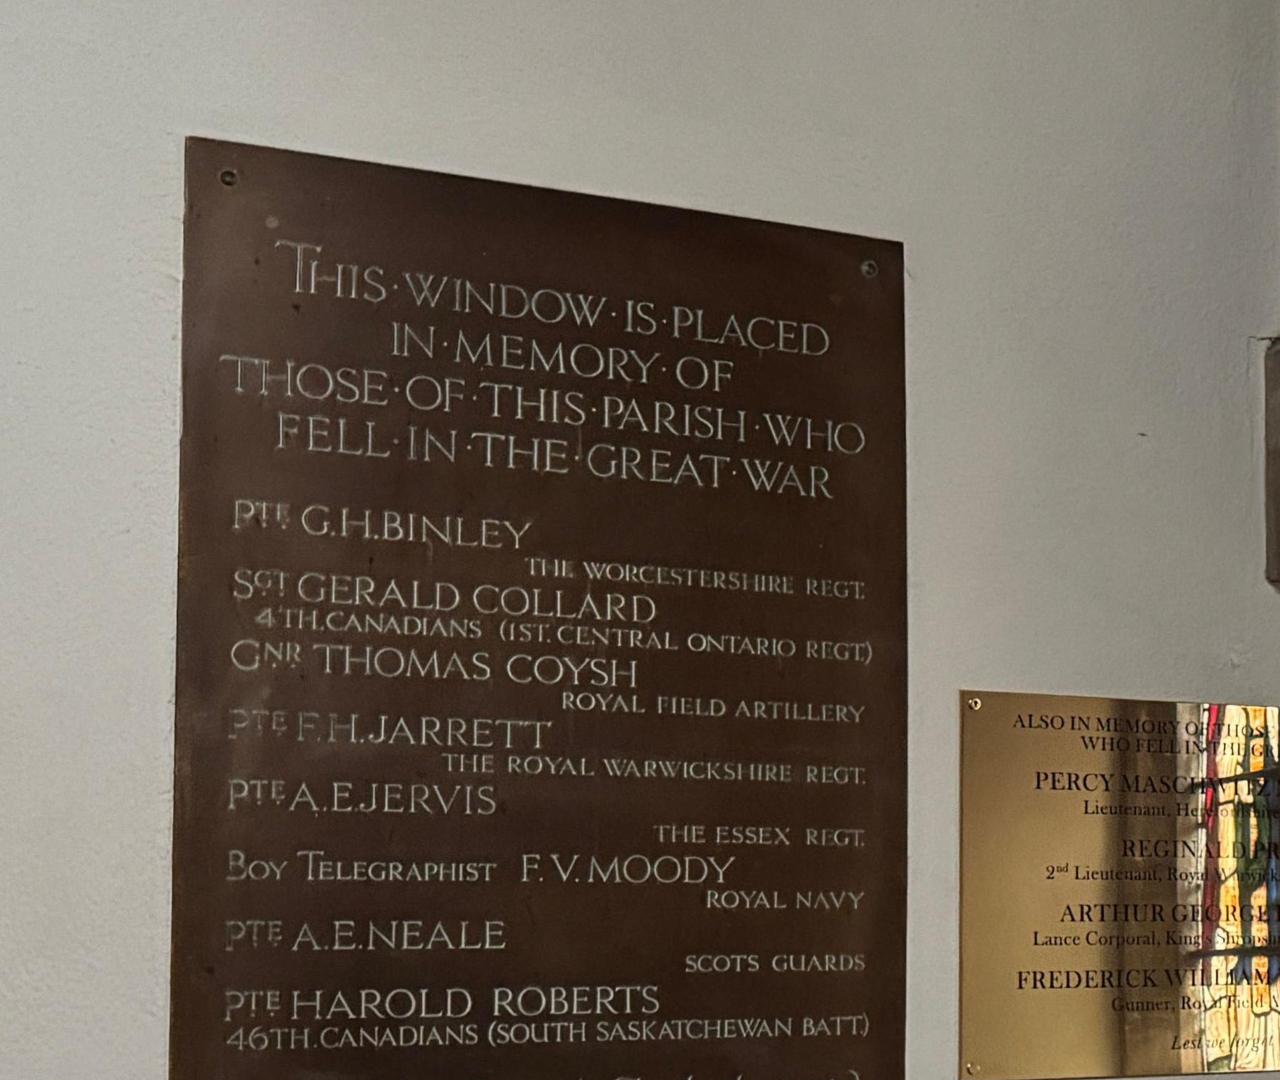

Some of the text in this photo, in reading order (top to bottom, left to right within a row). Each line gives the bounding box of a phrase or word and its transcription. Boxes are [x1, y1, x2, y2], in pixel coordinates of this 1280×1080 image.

[276, 240, 830, 356] THIS WINDOW IS PLACED
[391, 322, 734, 391] IN MEMORY OF
[219, 354, 866, 455] THOSE OF THIS PARISH WHO
[276, 413, 834, 498] FELL IN THE GREAT WAR
[525, 557, 574, 578] THE
[583, 561, 795, 594] WORCESTERSHIRE
[298, 573, 459, 612] GERALD
[473, 584, 656, 623] COLLARD
[557, 626, 678, 651] CENTRAL
[688, 633, 796, 657] ONTARIO
[312, 643, 490, 680] THOMAS
[506, 654, 637, 688] COYSH
[562, 692, 865, 723] ROYAL FIELD ARTILLERY
[1013, 713, 1065, 731] ALSO
[1070, 716, 1091, 733] IN
[1096, 718, 1181, 738] MEMORY
[1081, 736, 1131, 753] WHO
[1135, 738, 1181, 755] FELL
[442, 754, 494, 773] THE
[507, 755, 595, 777] ROYAL
[604, 758, 792, 784] WARWICKSHIRE
[1035, 772, 1114, 793] PERCY
[654, 824, 705, 845] THE
[716, 825, 791, 846] ESSEX
[1121, 839, 1247, 860] REGINALD
[588, 855, 736, 885] MOODY
[706, 890, 866, 910] ROYAL NAVY
[1060, 904, 1165, 923] ARTHUR
[1033, 931, 1081, 947] Lance
[1085, 931, 1161, 950] Corporal,
[685, 953, 866, 974] SCOTS GUARDS
[1017, 969, 1158, 990] FREDERICK
[290, 987, 473, 1020] HAROLD
[492, 985, 661, 1017] ROBERTS
[487, 1021, 588, 1047] (SOUTH
[596, 1017, 793, 1043] SASKATCHEWAN
